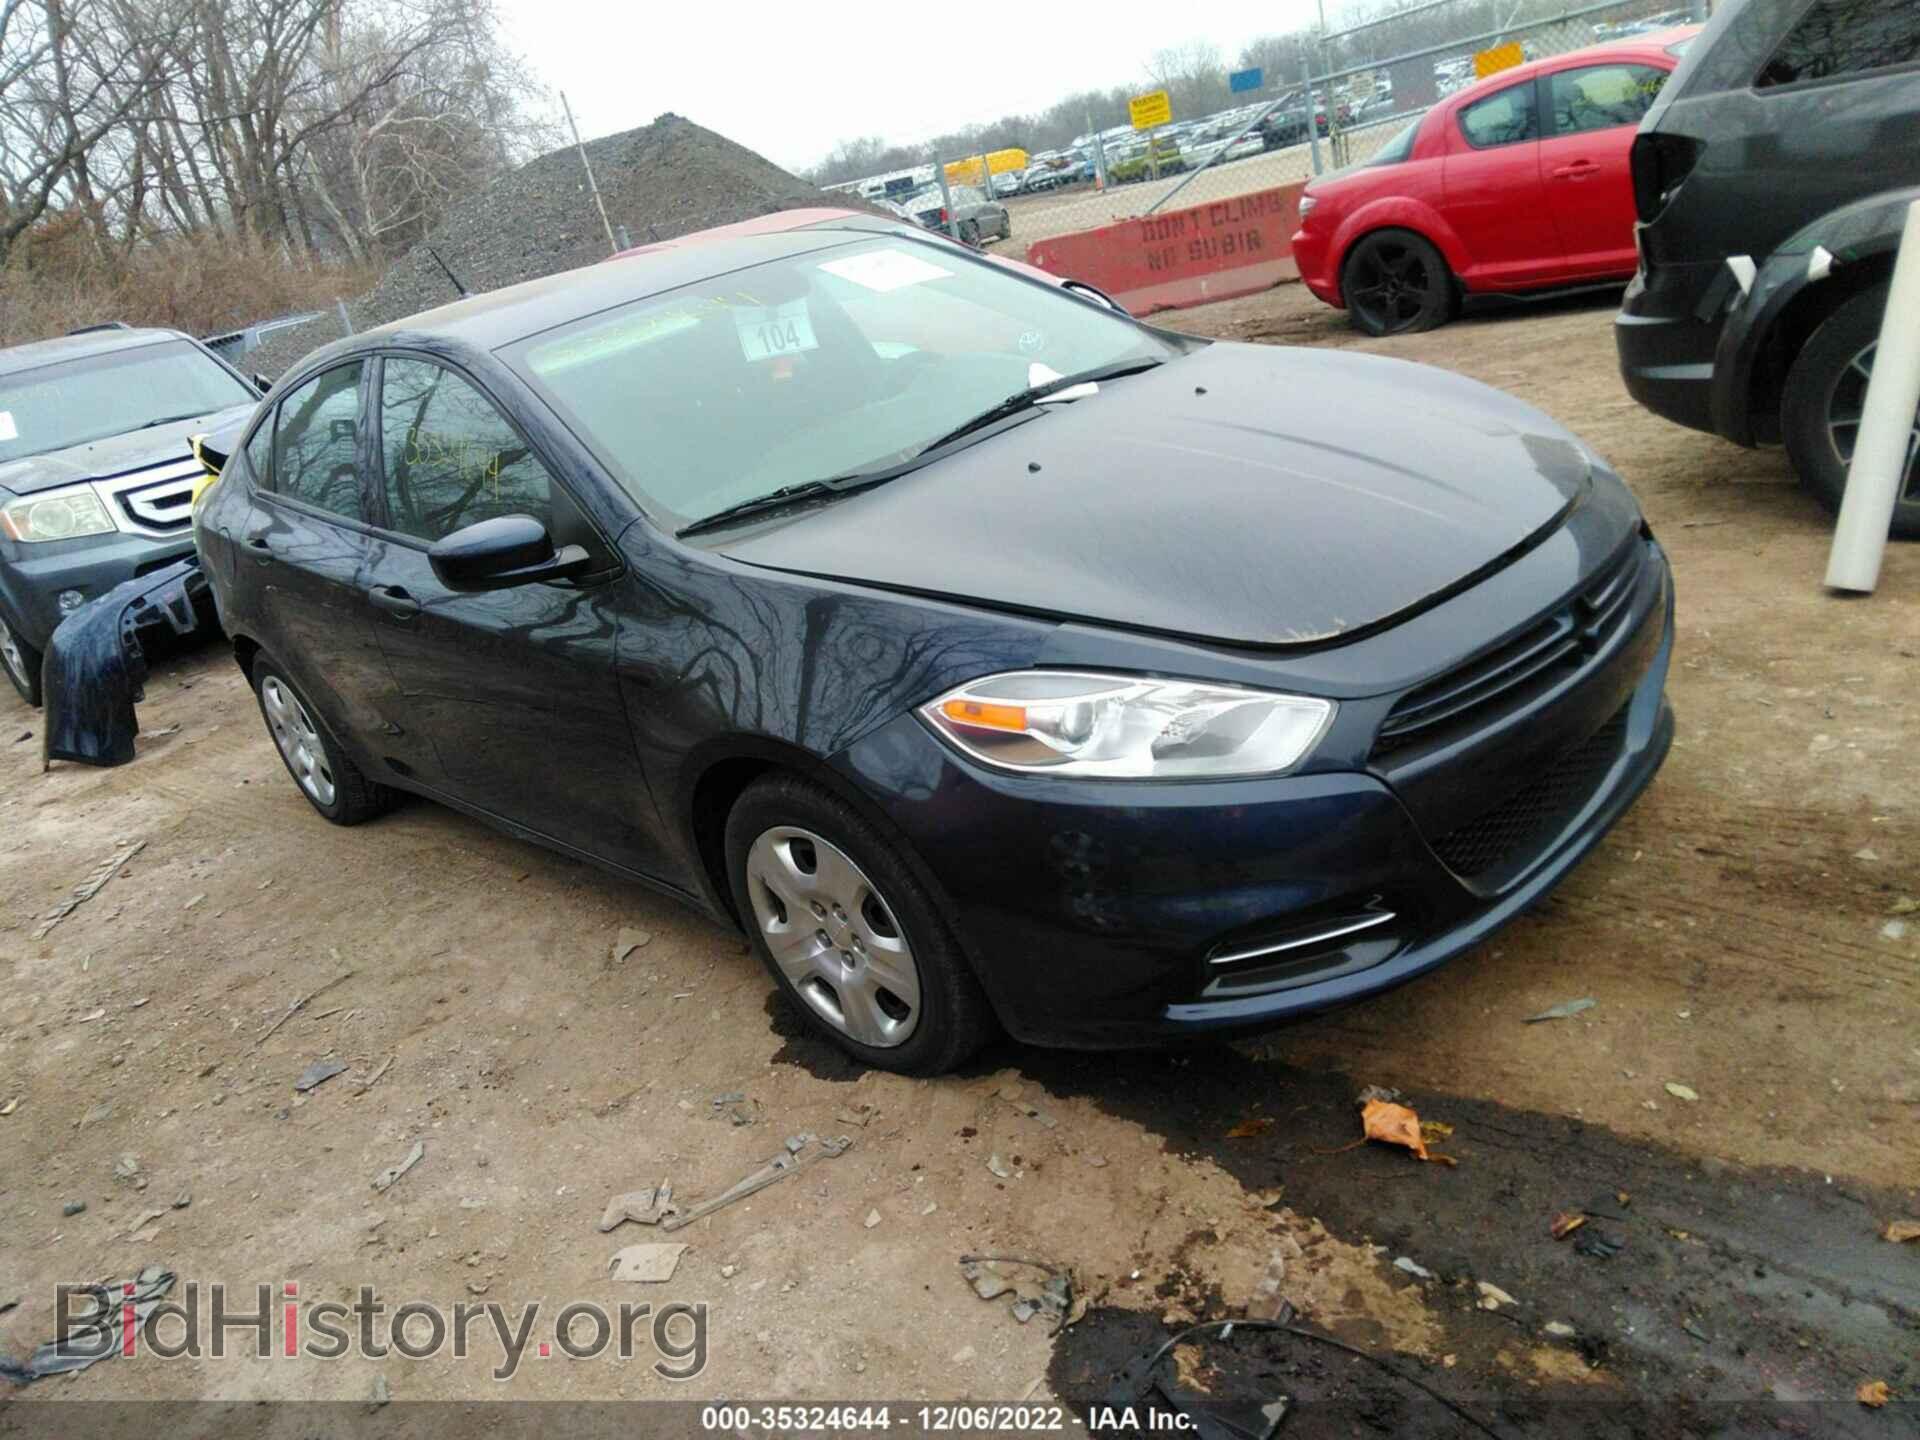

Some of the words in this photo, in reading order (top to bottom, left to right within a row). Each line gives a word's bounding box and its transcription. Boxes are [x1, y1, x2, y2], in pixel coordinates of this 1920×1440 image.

[1210, 192, 1281, 226] CLIMB
[1190, 229, 1261, 261] SUBIR
[756, 320, 800, 353] 104
